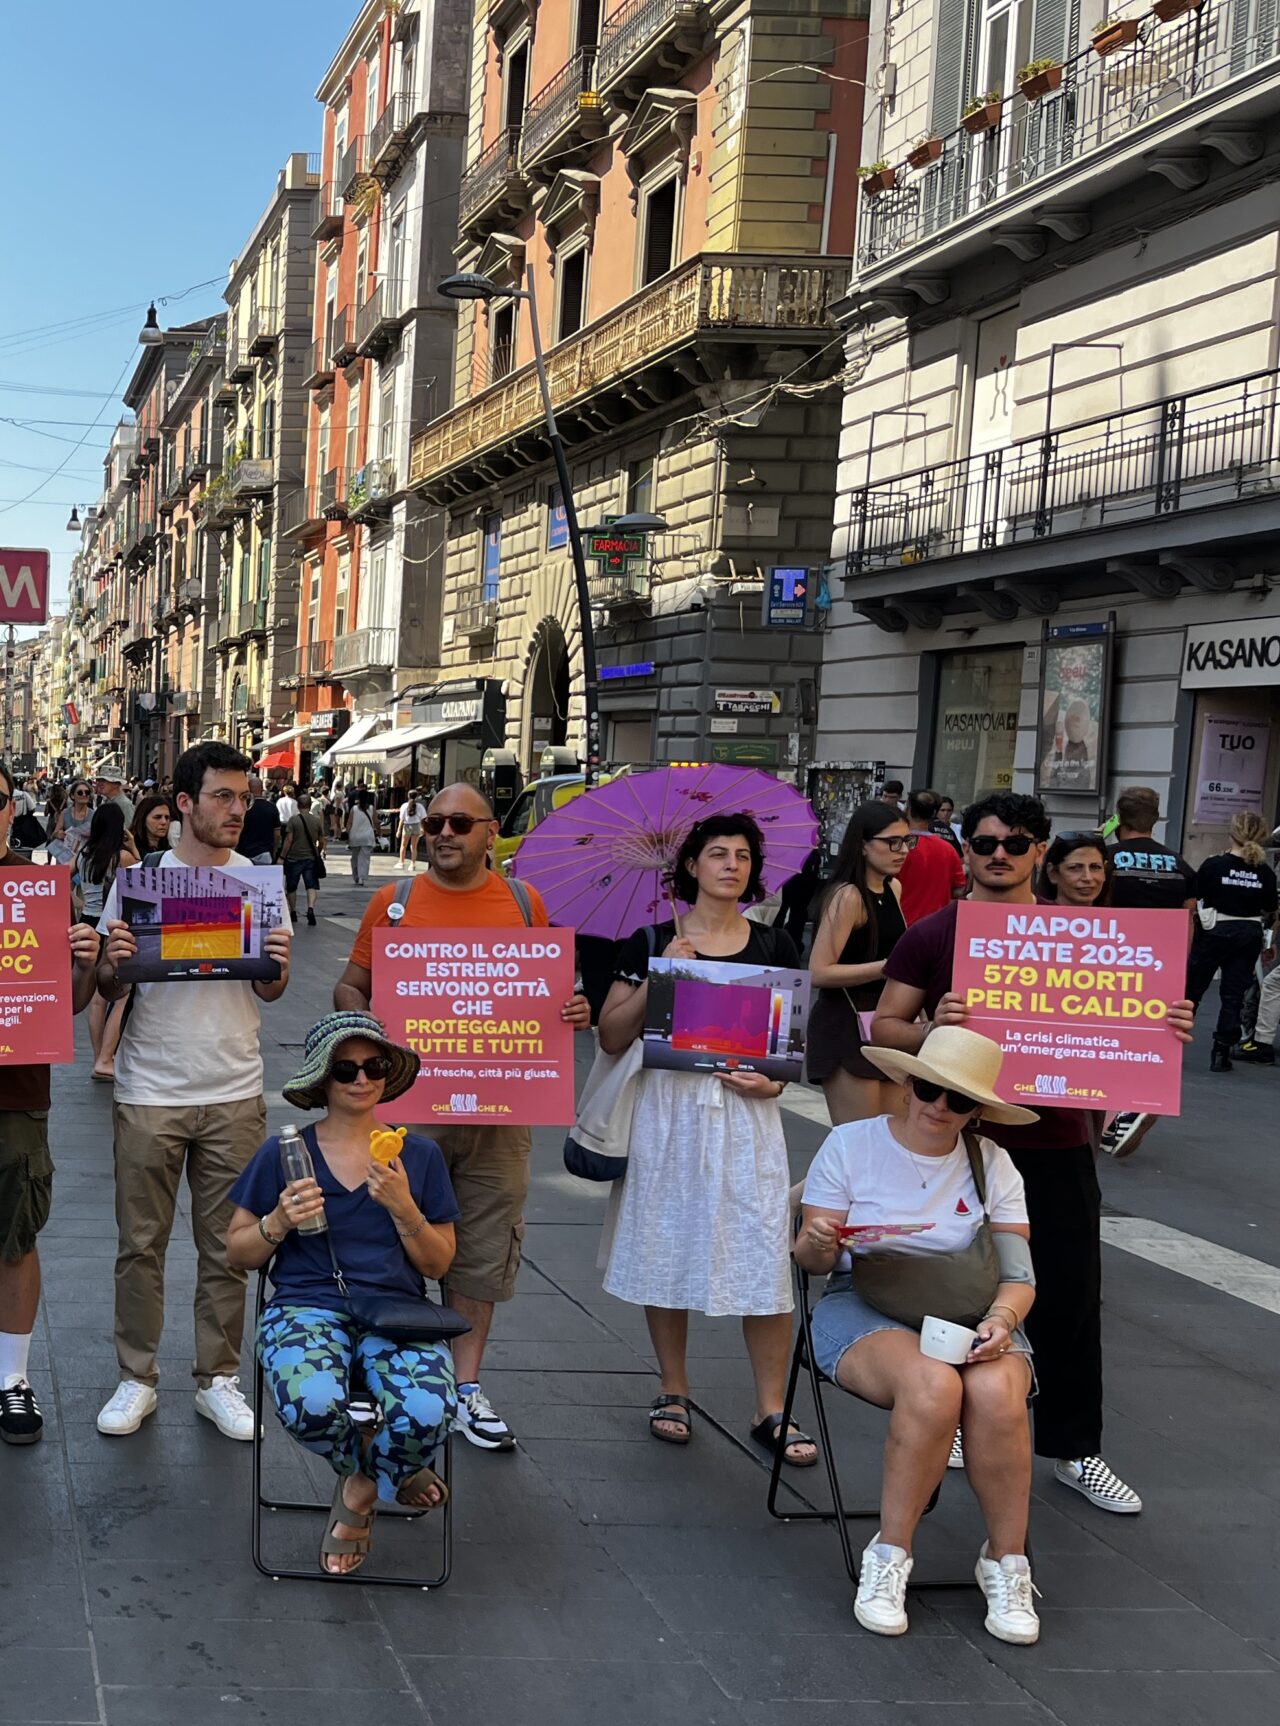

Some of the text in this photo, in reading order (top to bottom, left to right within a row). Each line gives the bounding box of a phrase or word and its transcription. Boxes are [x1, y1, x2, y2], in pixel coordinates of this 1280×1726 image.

[593, 539, 638, 551] FARMACIA
[441, 700, 476, 719] CATAPANO
[727, 702, 770, 711] TABACCHI
[944, 712, 1006, 731] KASANOVA
[1219, 734, 1255, 750] TUO
[1221, 876, 1263, 889] Municipale
[1229, 869, 1258, 880] Polizia
[3, 880, 56, 897] OGGI
[11, 898, 26, 923] È
[1006, 914, 1126, 944] NAPOLI,
[384, 943, 561, 959] CONTRO IL CALDO
[969, 937, 1164, 971] ESTATE 2025,
[426, 962, 519, 978] ESTREMO
[983, 964, 1143, 992] 579 MORTI
[395, 977, 550, 997] SERVONO CITTÀ
[4, 1006, 22, 1017] per
[23, 1004, 33, 1014] le
[451, 1000, 493, 1015] CHE
[966, 988, 1167, 1020] PER IL CALDO
[405, 1019, 541, 1035] PROTEGGANO
[406, 1038, 543, 1055] TUTTE E TUTTI
[1006, 1029, 1120, 1048] La crisi climatica
[0, 1045, 14, 1054] FA.
[1098, 1049, 1164, 1064] sanitaria.
[433, 1067, 476, 1079] fresche,
[478, 1068, 502, 1078] città
[504, 1069, 522, 1080] più
[524, 1069, 560, 1081] giuste.
[1013, 1083, 1035, 1093] CHE
[1035, 1074, 1067, 1095] CALDO
[1067, 1087, 1089, 1097] CHE
[1091, 1088, 1107, 1098] FA.
[431, 1093, 512, 1113] CHE CALDO CHE FA.
